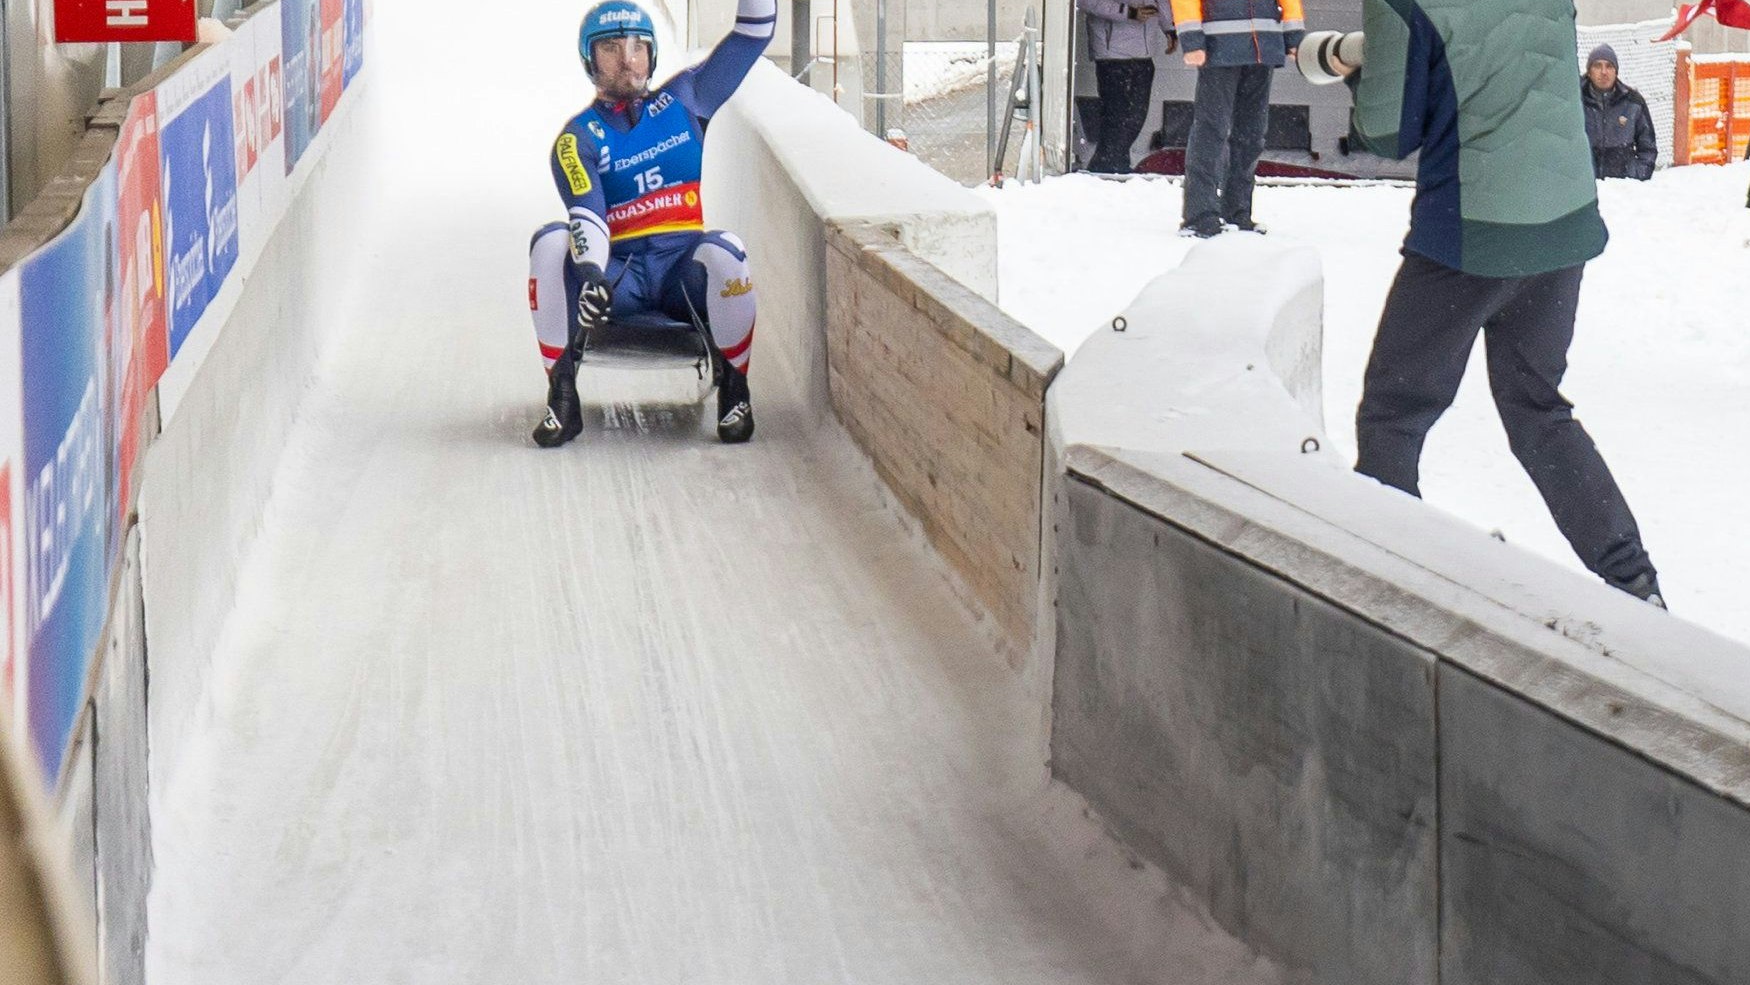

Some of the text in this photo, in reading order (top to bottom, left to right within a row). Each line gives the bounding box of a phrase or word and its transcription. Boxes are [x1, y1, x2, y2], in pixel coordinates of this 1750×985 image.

[599, 9, 642, 25] stubai
[559, 136, 588, 191] PALFINGER
[614, 130, 691, 172] Eberspächer
[633, 166, 664, 194] 15
